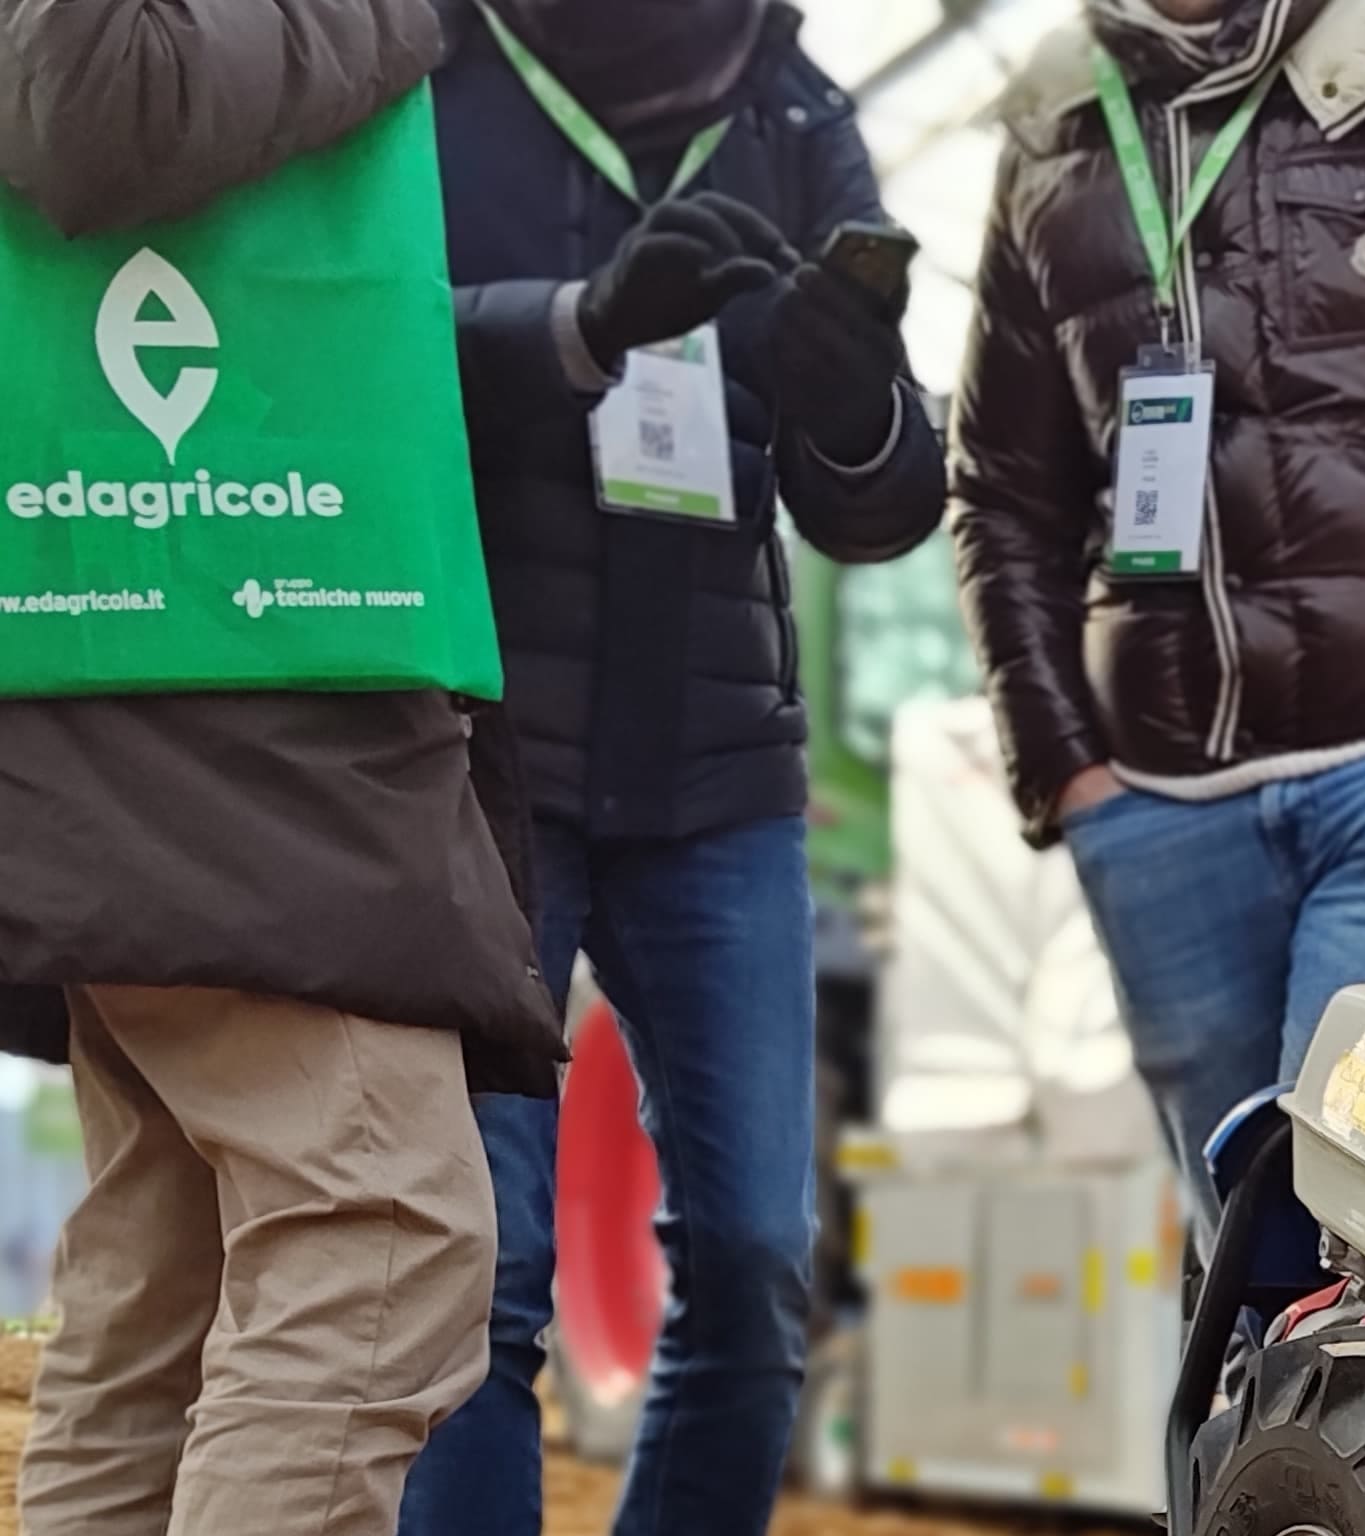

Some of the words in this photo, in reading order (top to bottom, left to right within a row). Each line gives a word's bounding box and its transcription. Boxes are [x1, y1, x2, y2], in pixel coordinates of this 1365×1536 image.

[6, 468, 344, 529] edagricole
[275, 587, 361, 607] tecniche
[365, 590, 425, 607] nuove
